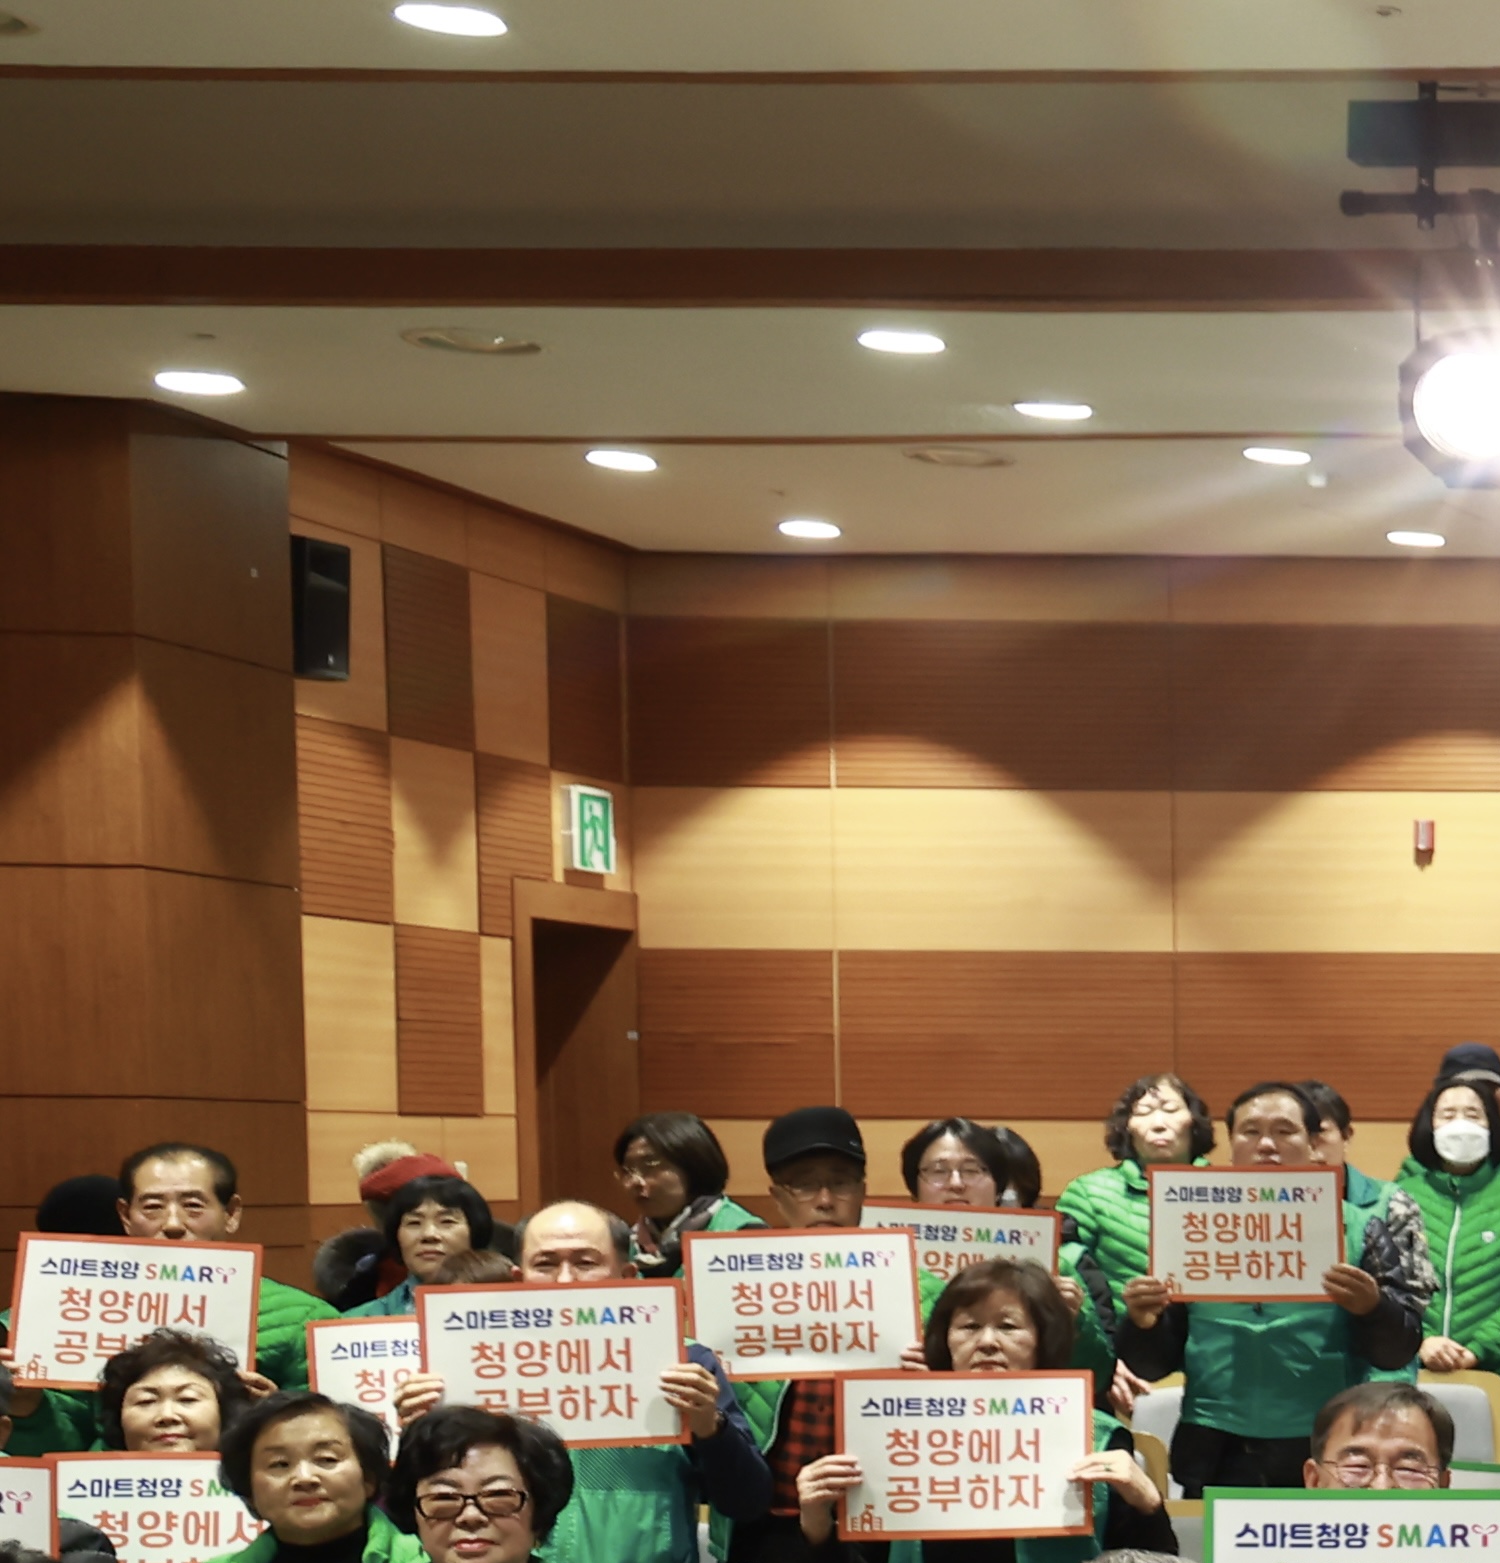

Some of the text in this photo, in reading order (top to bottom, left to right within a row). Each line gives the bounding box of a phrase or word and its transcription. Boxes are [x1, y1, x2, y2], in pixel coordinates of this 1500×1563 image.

[1165, 1187, 1242, 1203] 스마트청양
[1183, 1212, 1303, 1243] 청양에서
[40, 1258, 140, 1279] 스마트청양
[708, 1253, 803, 1272] 스마트청양
[1183, 1250, 1307, 1281] 공부하자
[59, 1287, 206, 1328] 청양에서
[732, 1280, 873, 1316] 청양에서
[445, 1308, 553, 1330] 스마트청양
[733, 1321, 879, 1357] 공부하자
[471, 1337, 632, 1379] 청양에서
[861, 1398, 966, 1417] 스마트청양
[885, 1428, 1039, 1467] 청양에서
[68, 1478, 182, 1498] 스마트청양
[886, 1474, 1044, 1514] 공부하자
[1235, 1523, 1369, 1548] 스마트청양
